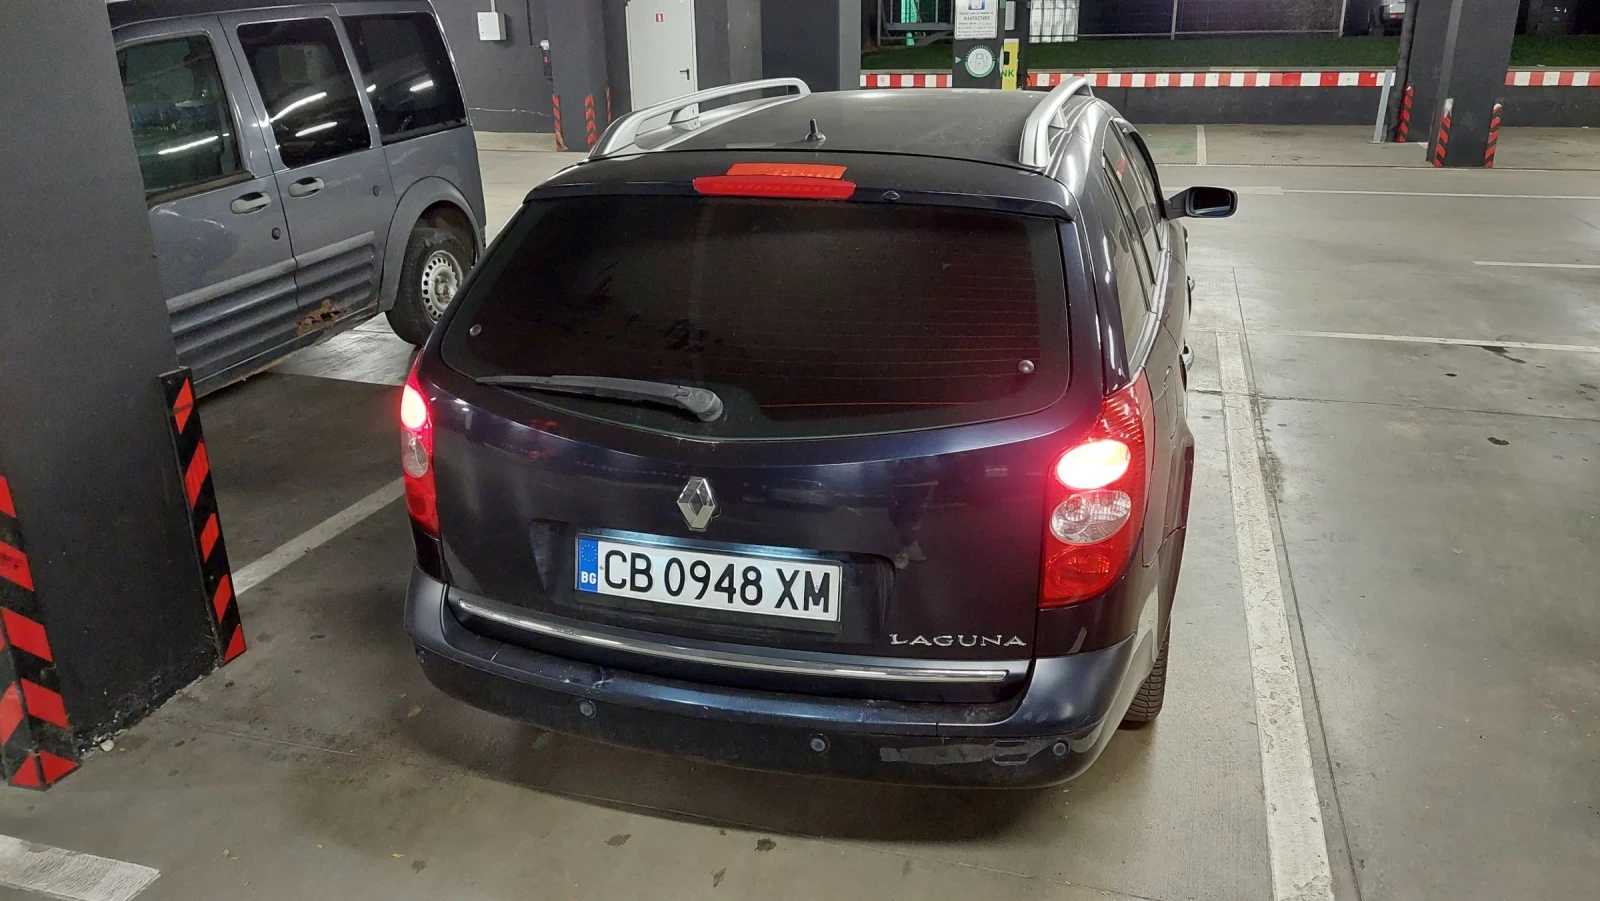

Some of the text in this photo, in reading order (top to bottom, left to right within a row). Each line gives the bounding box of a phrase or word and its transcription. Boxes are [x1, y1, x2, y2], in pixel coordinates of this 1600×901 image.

[581, 571, 597, 585] BG
[604, 550, 831, 613] CB 0948 XM
[889, 633, 1027, 647] LAGUNA
